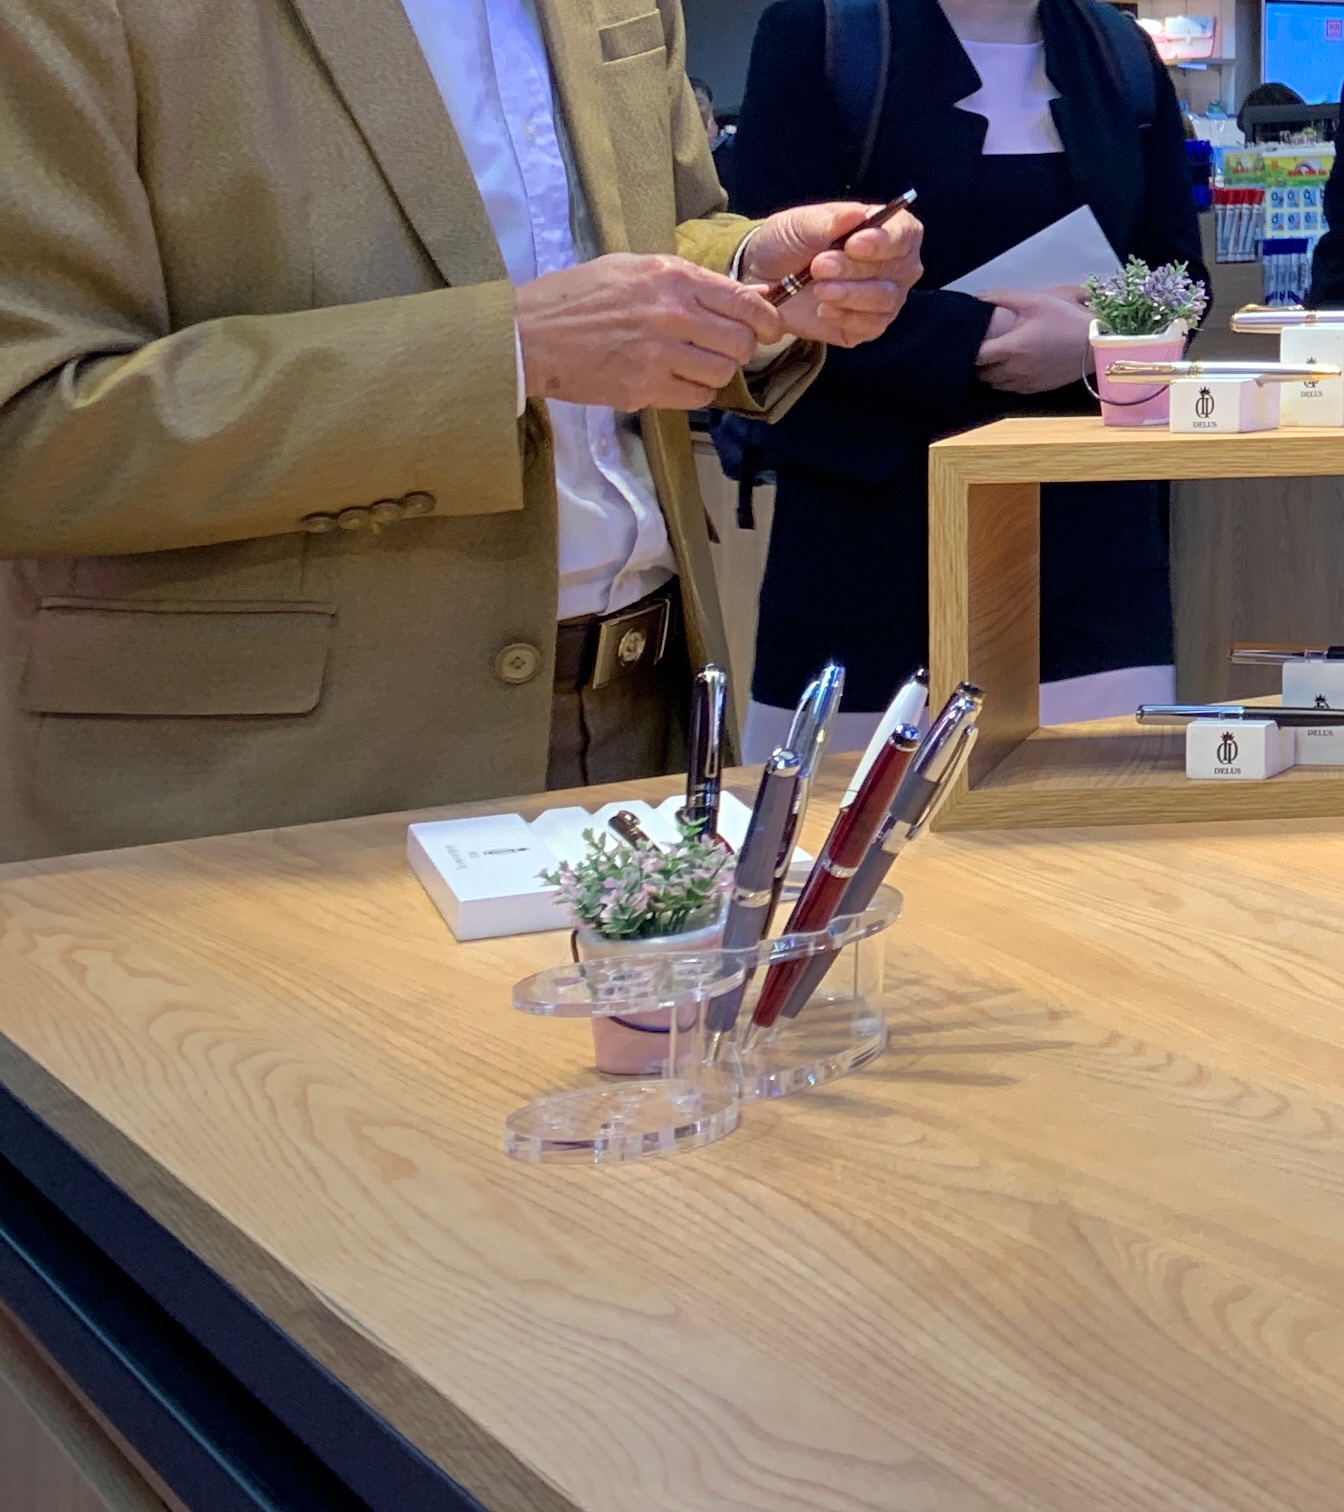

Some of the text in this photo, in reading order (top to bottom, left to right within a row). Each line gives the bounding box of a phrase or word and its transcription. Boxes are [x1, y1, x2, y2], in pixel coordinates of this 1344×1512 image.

[1301, 390, 1323, 398] DELUS
[1192, 421, 1217, 429] DELUS
[1307, 729, 1334, 737] DELUS
[1214, 767, 1241, 775] DELUS
